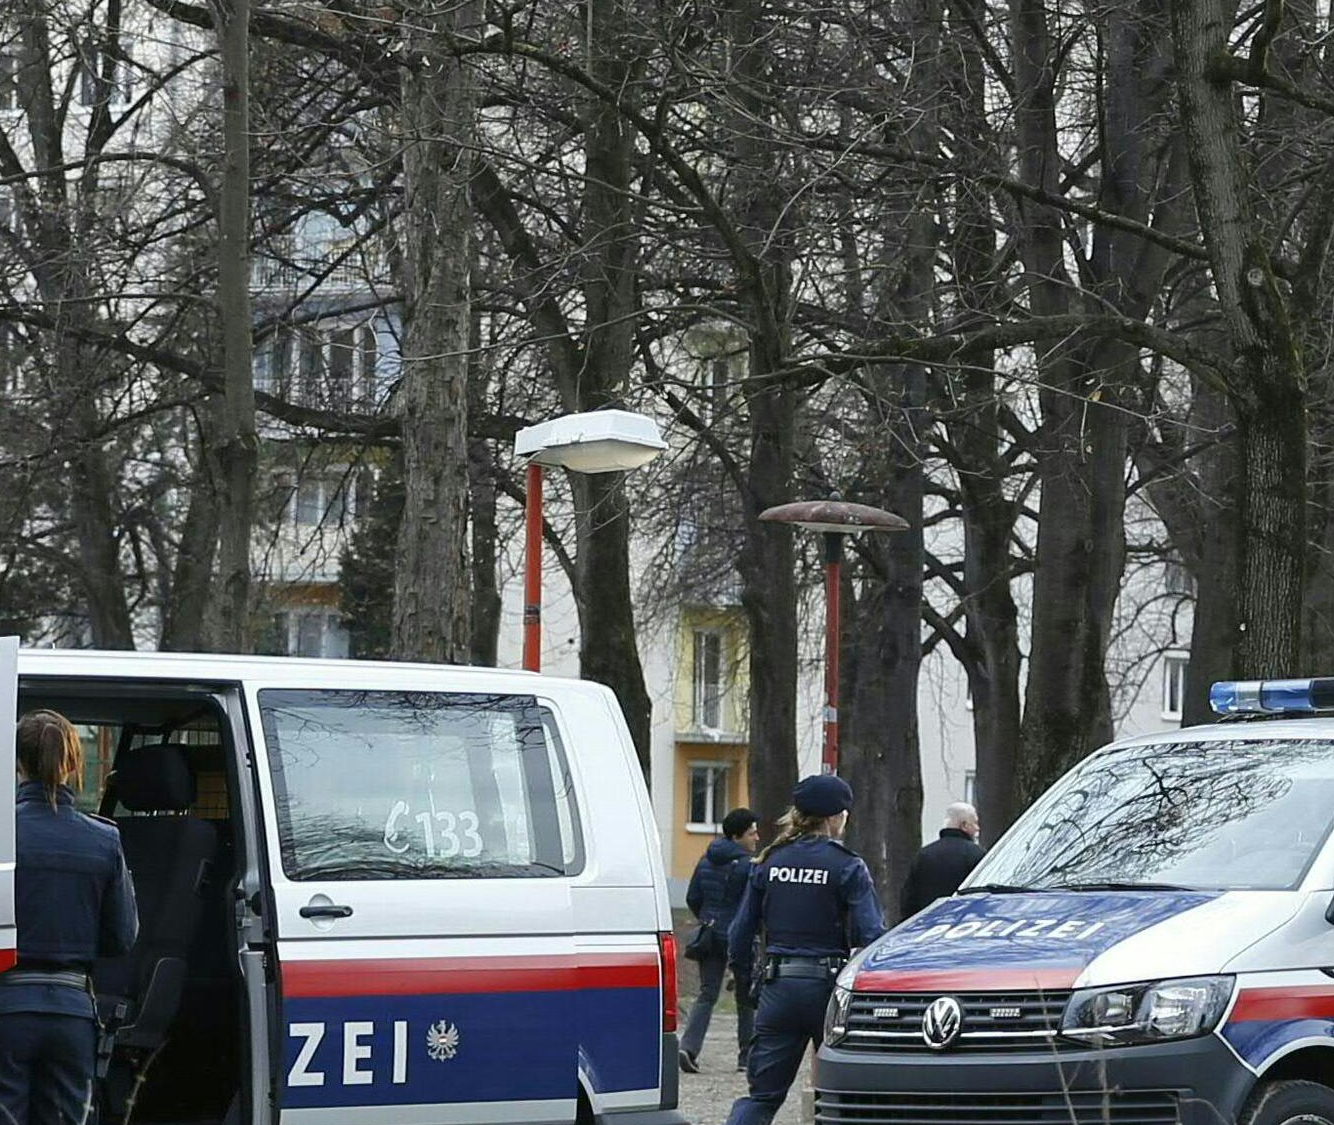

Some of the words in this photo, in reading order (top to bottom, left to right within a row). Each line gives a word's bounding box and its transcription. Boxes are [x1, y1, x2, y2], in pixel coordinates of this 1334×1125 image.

[415, 811, 483, 858] 133
[769, 867, 829, 885] POLIZEI
[914, 918, 1105, 944] POLIZEI
